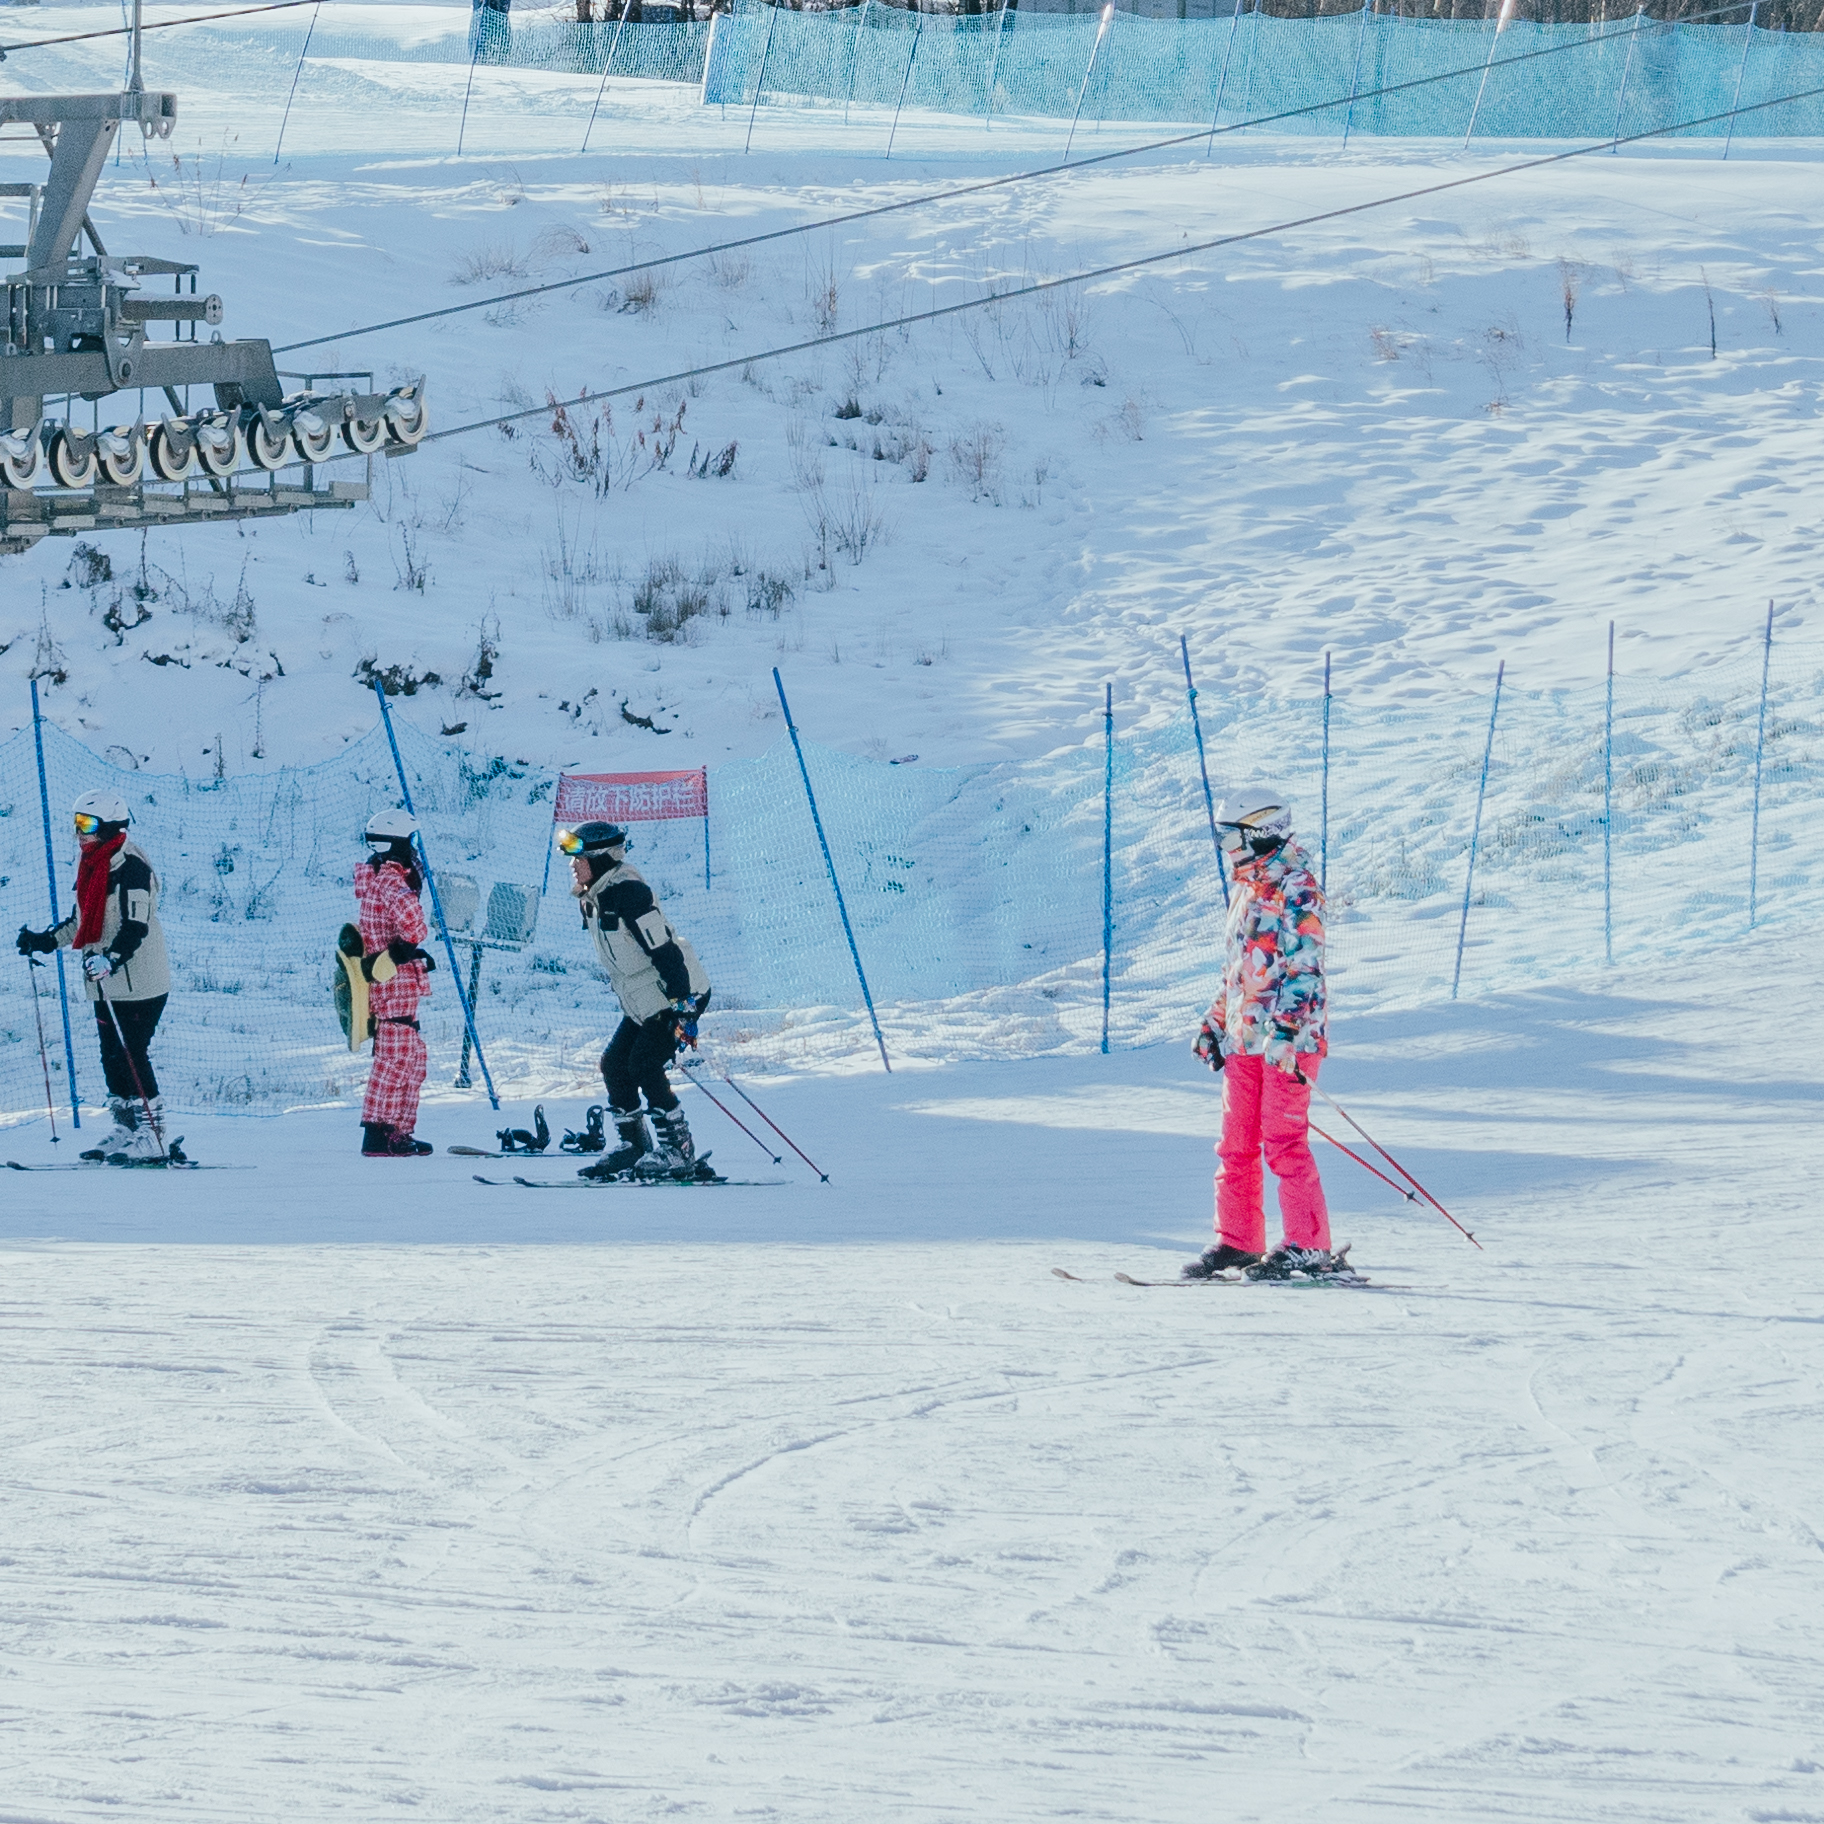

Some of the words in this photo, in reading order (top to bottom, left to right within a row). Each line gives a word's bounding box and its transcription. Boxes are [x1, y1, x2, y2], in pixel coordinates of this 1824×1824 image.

[564, 783, 696, 813] 请放下防护栏
